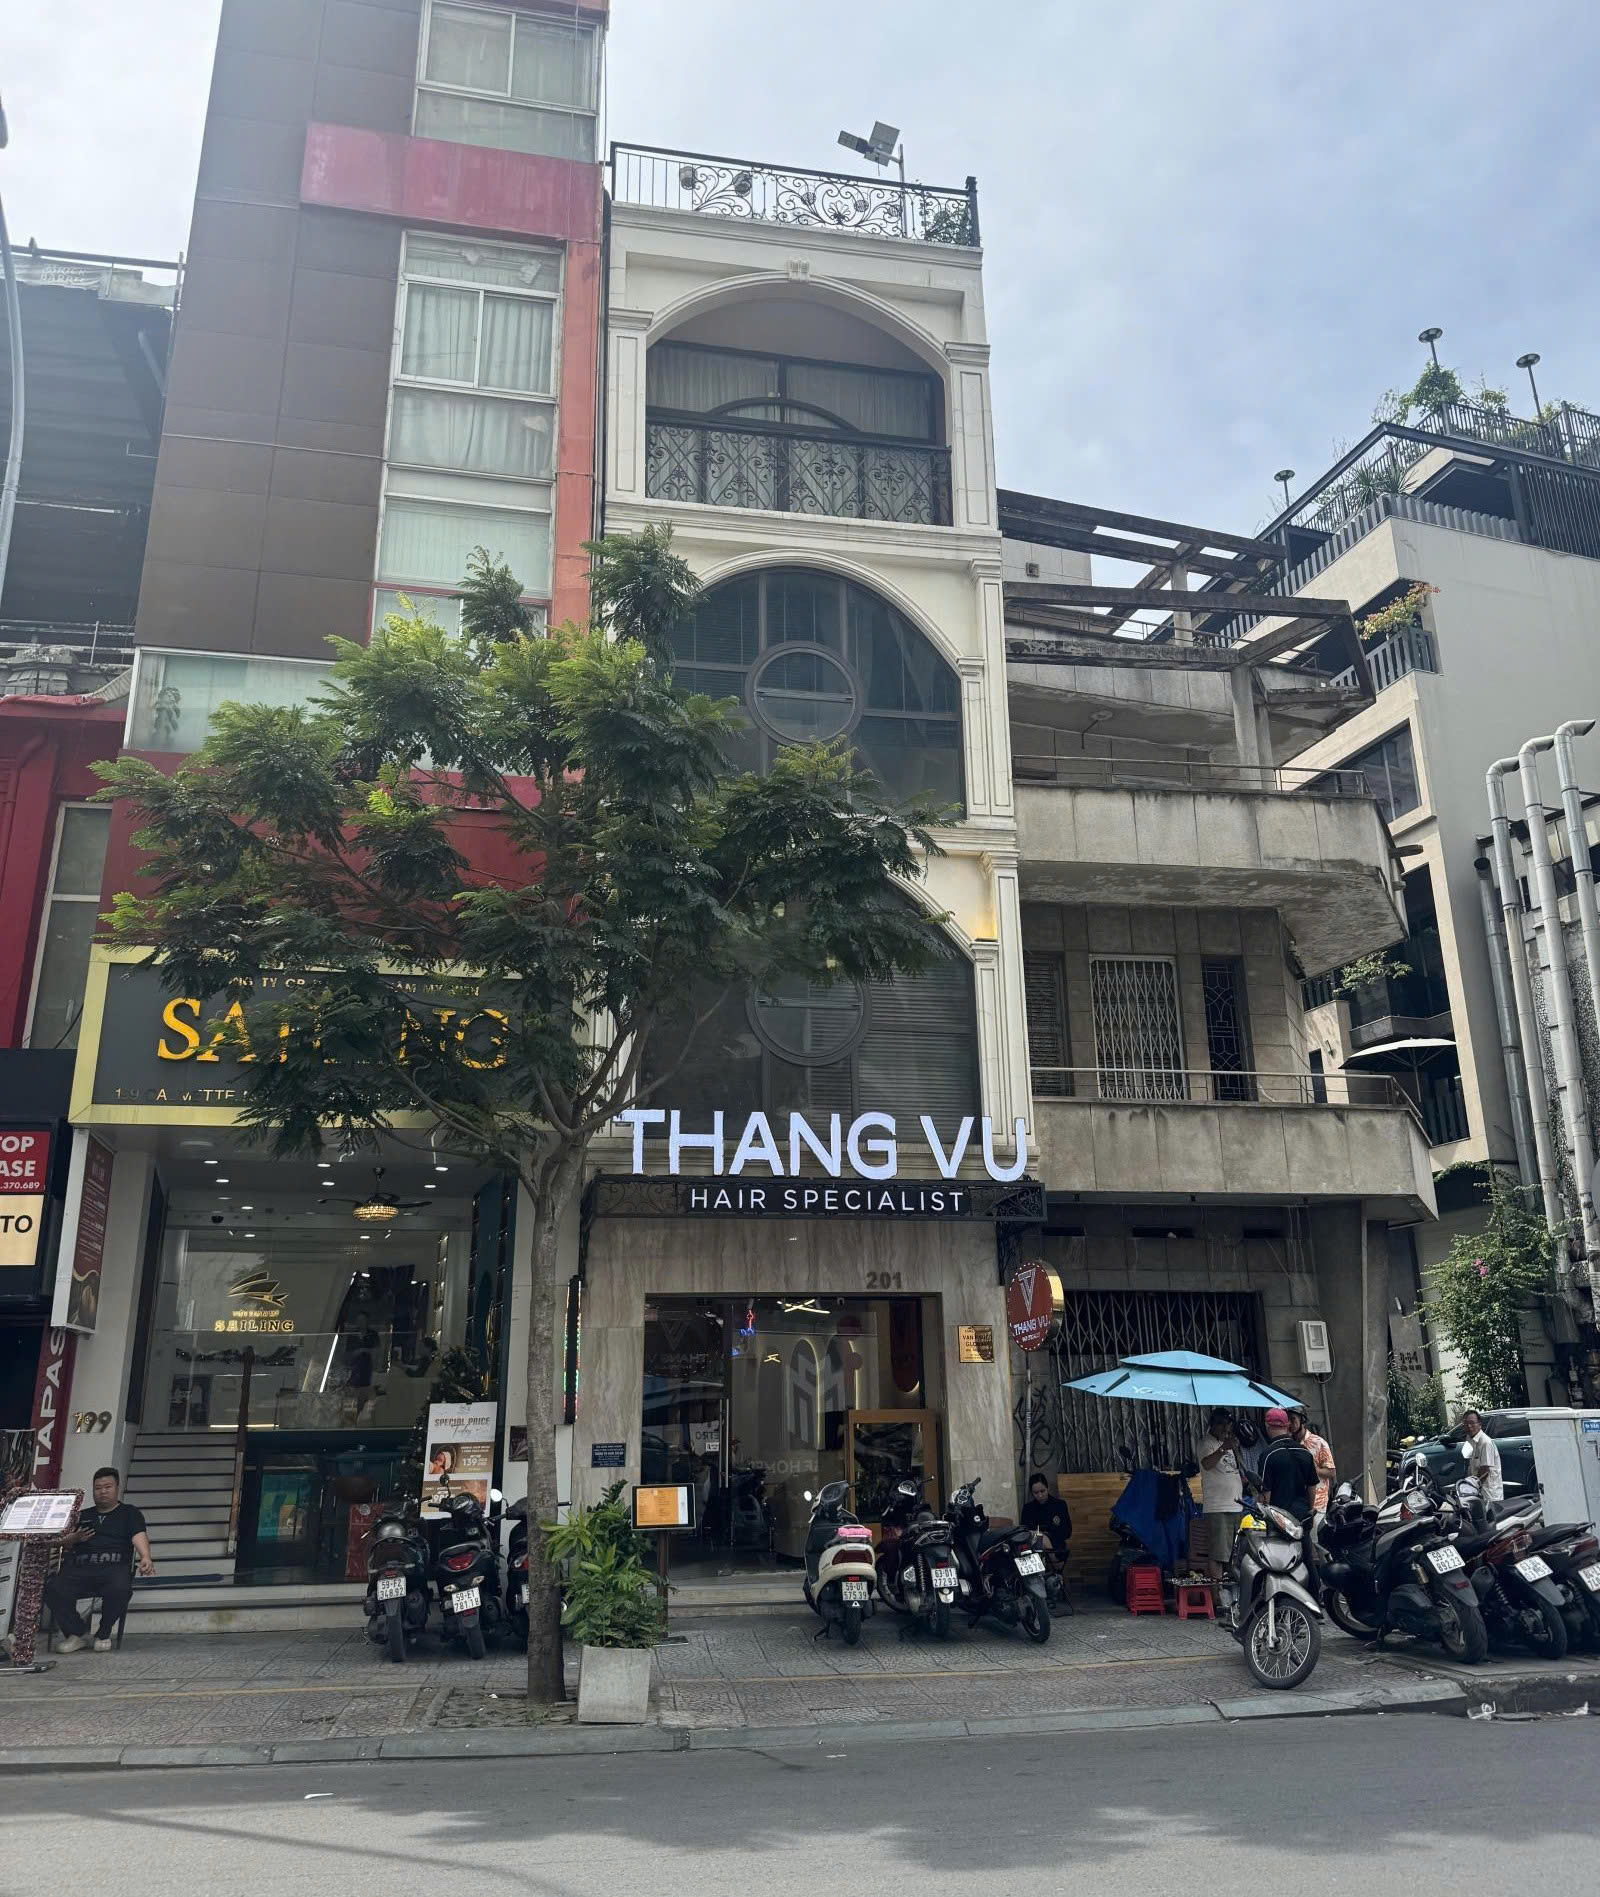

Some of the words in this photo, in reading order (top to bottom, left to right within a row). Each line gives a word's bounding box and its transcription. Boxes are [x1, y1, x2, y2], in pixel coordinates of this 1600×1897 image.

[613, 1108, 898, 1180] THANG
[919, 1115, 1028, 1182] VU
[691, 1189, 766, 1209] HAIR
[784, 1189, 964, 1212] SPECIALIST
[866, 1271, 902, 1290] 201
[214, 1319, 295, 1332] SAILING
[1013, 1318, 1037, 1337] THANG
[33, 1327, 67, 1471] TAPAS
[72, 1410, 113, 1434] 199
[434, 1418, 466, 1427] SPECIAL
[468, 1417, 491, 1426] PRICE
[456, 1590, 475, 1602] 59-E1
